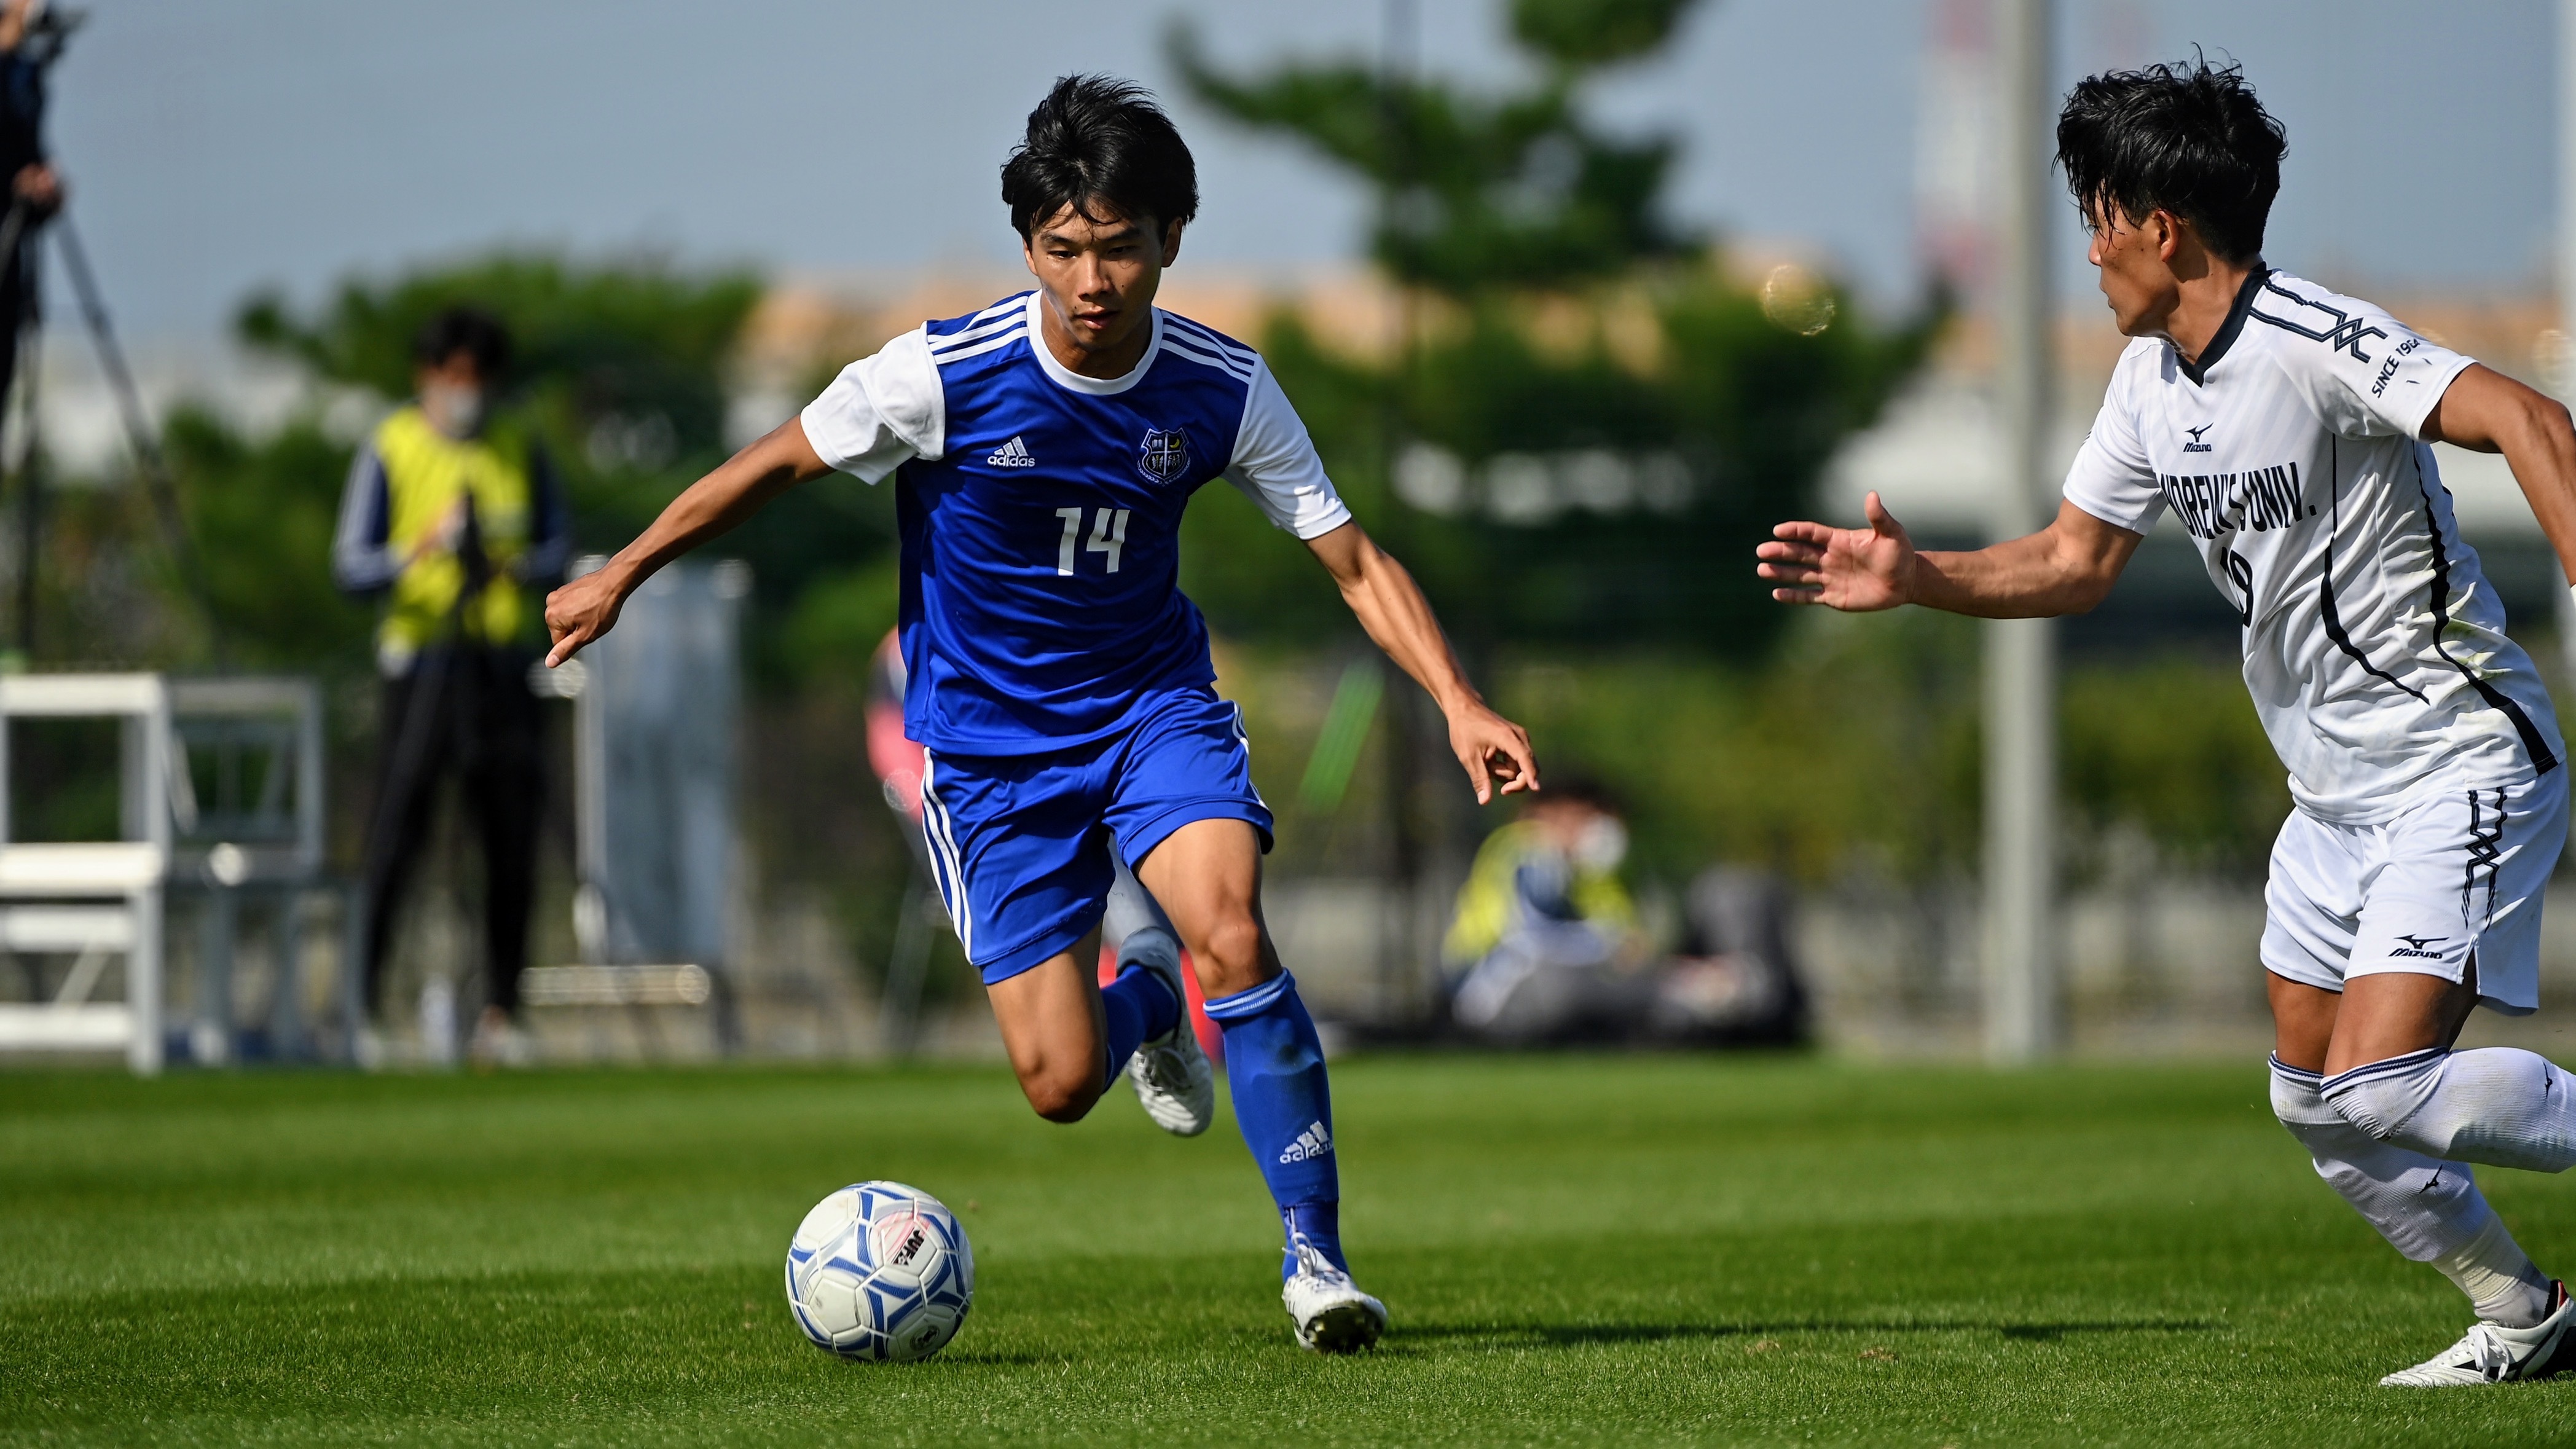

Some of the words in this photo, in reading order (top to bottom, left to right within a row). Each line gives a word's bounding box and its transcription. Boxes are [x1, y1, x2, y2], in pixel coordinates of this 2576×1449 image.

[2371, 355, 2400, 399] SINCE
[987, 455, 1035, 467] adidas
[2242, 461, 2317, 532] UNIV.
[1055, 507, 1131, 576] 14
